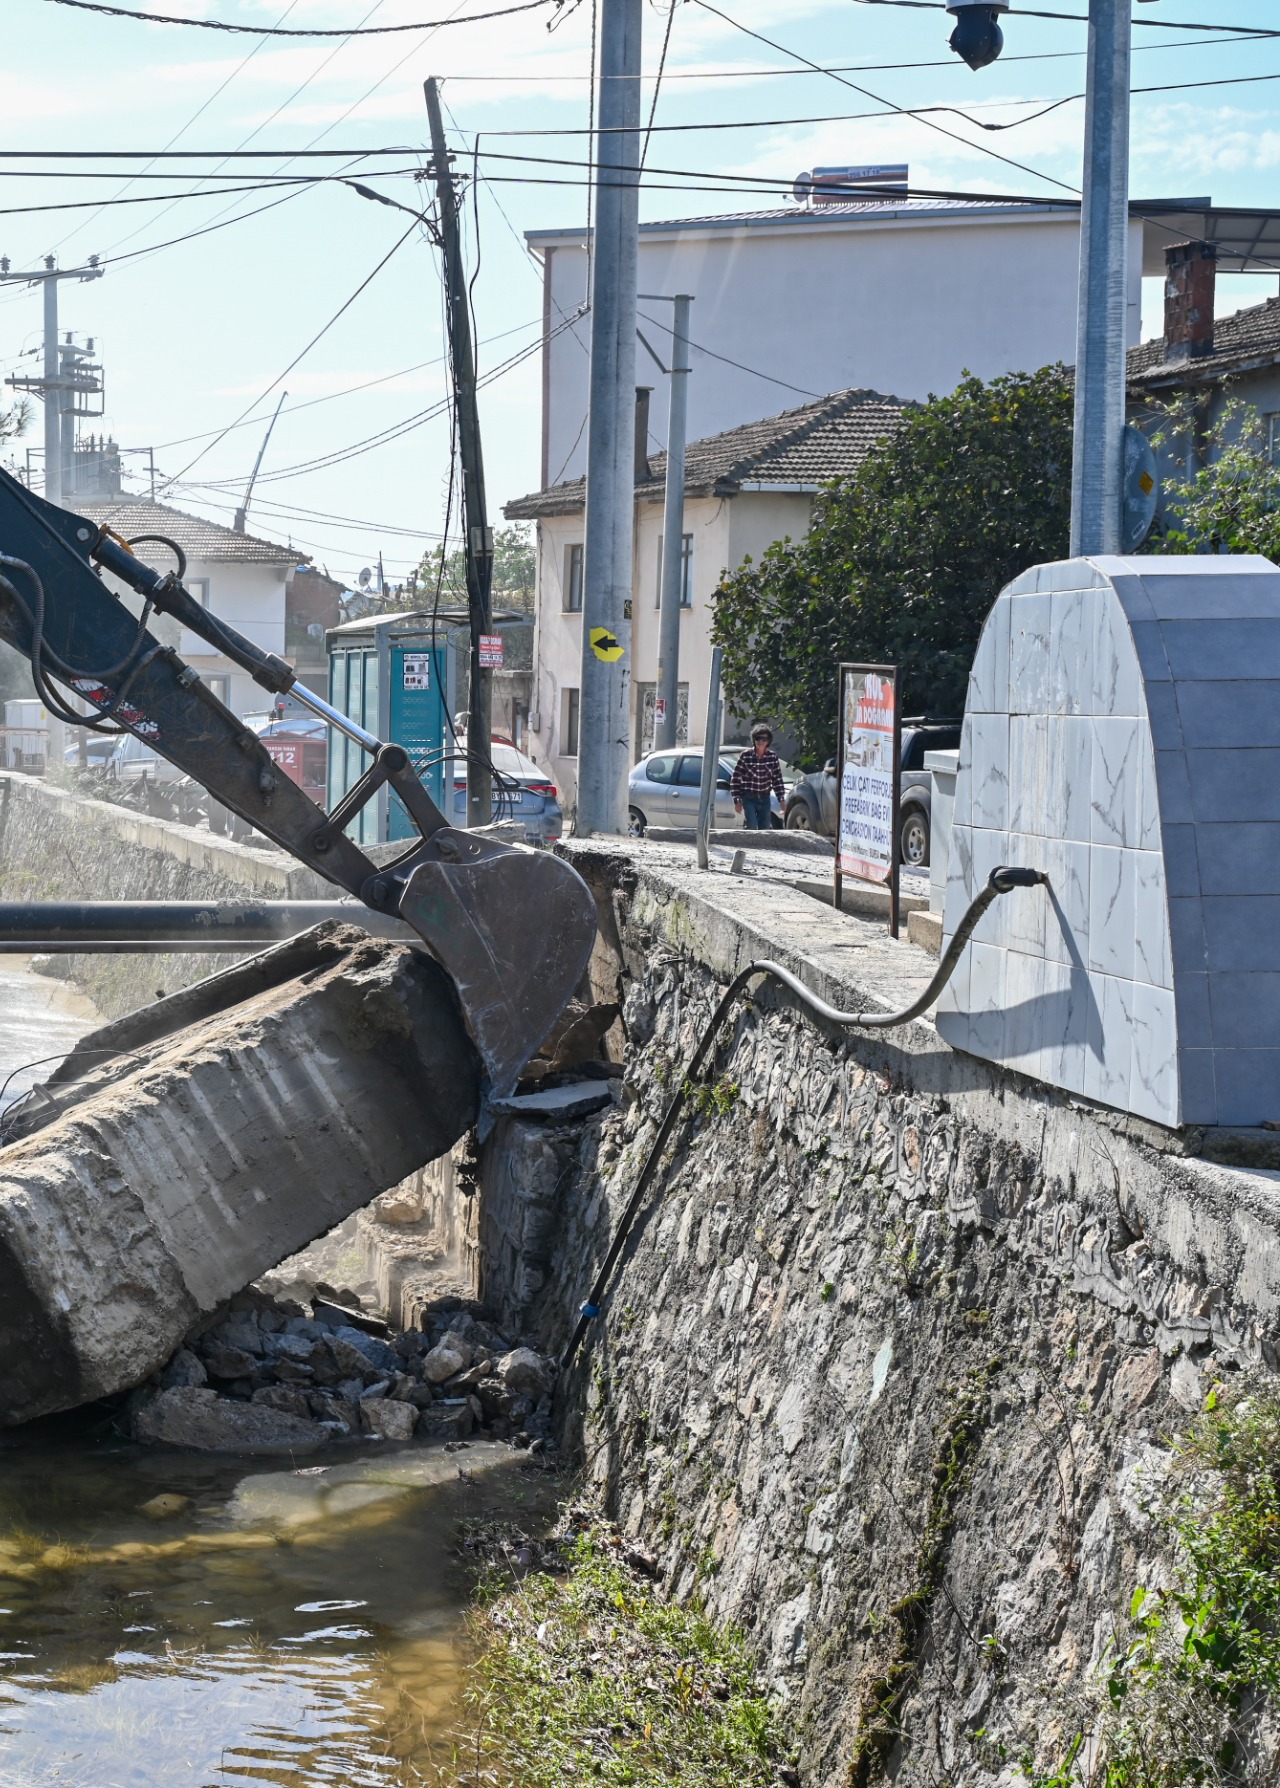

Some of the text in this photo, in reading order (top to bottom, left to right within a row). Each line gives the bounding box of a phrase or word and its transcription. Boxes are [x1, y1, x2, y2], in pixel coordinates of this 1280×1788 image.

[270, 752, 294, 763] 112
[842, 772, 857, 794] ÇELİK
[858, 776, 870, 796] ÇATI
[871, 800, 882, 820] BAĞ
